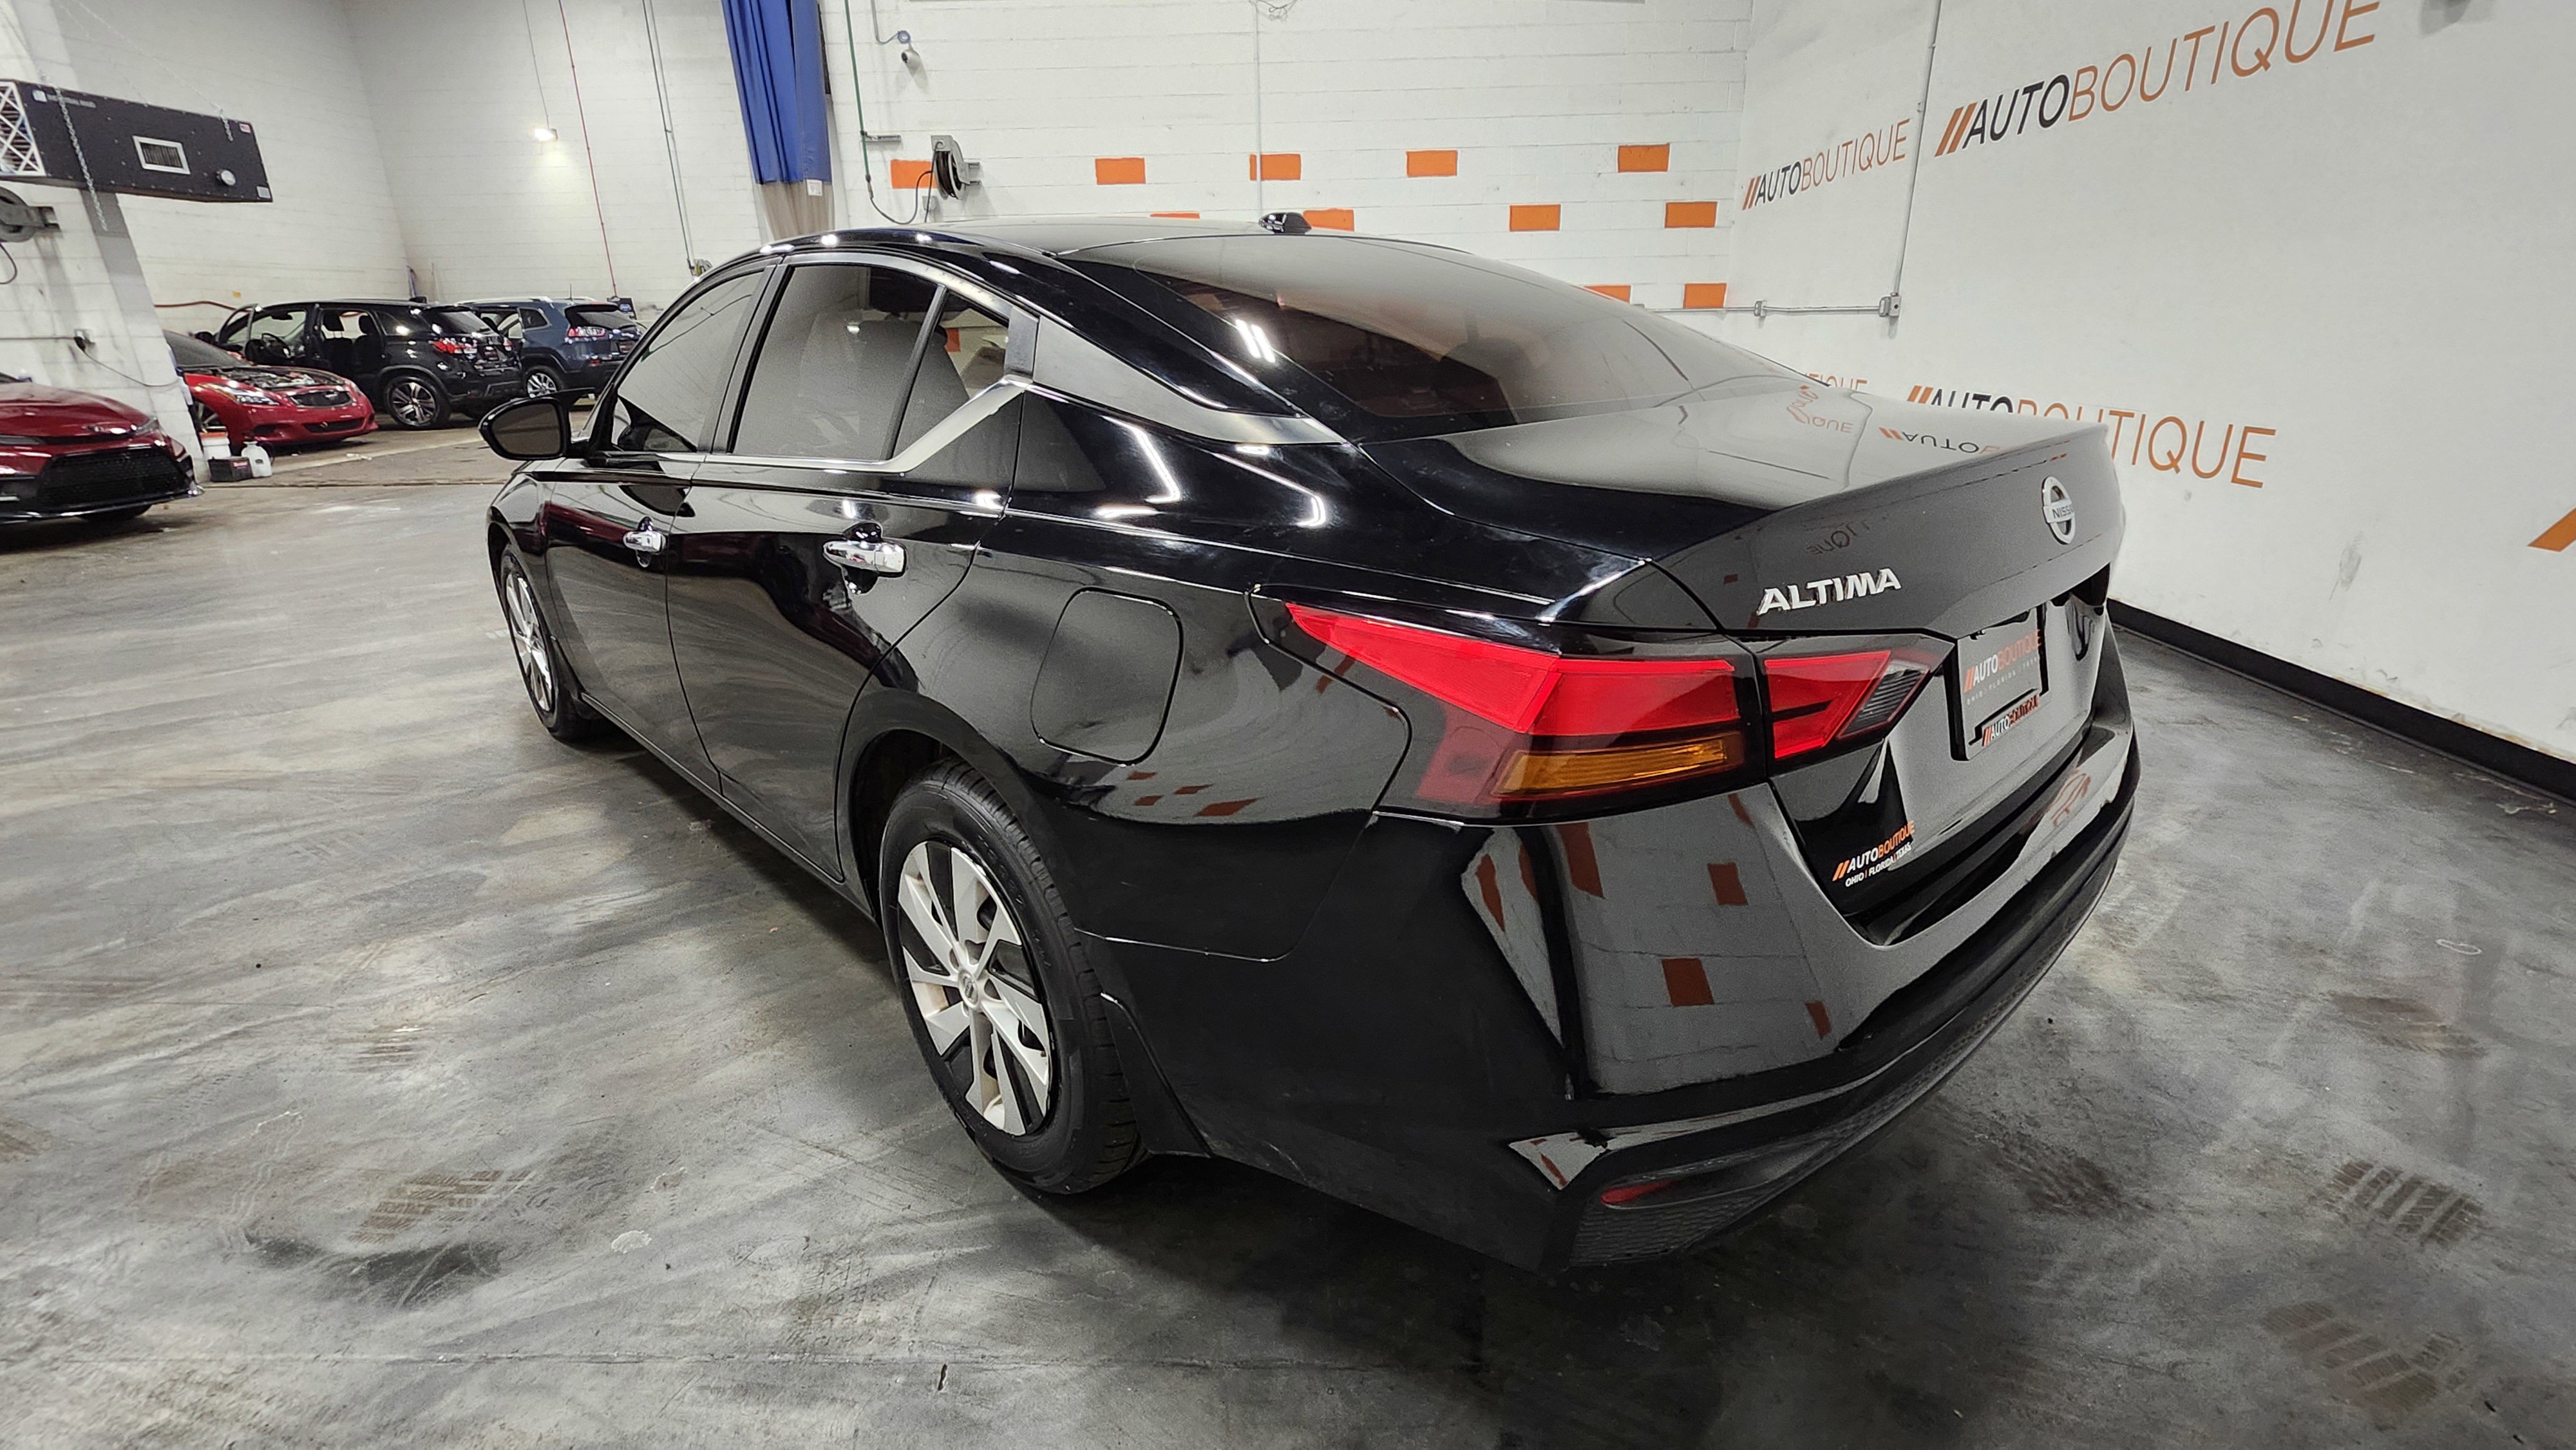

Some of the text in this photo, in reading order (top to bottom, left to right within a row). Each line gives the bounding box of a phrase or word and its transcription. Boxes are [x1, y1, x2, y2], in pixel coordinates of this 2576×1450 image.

[1755, 118, 1910, 207] AUTOBOUTIQUE
[1930, 388, 2277, 489] ATTIQUE
[2052, 505, 2074, 519] NISS
[1756, 568, 1902, 616] ALTIMA
[1845, 872, 1864, 887] OHIO
[1868, 855, 1896, 876] FLORIDA
[1846, 820, 1915, 874] AUTOBOUTIQUE
